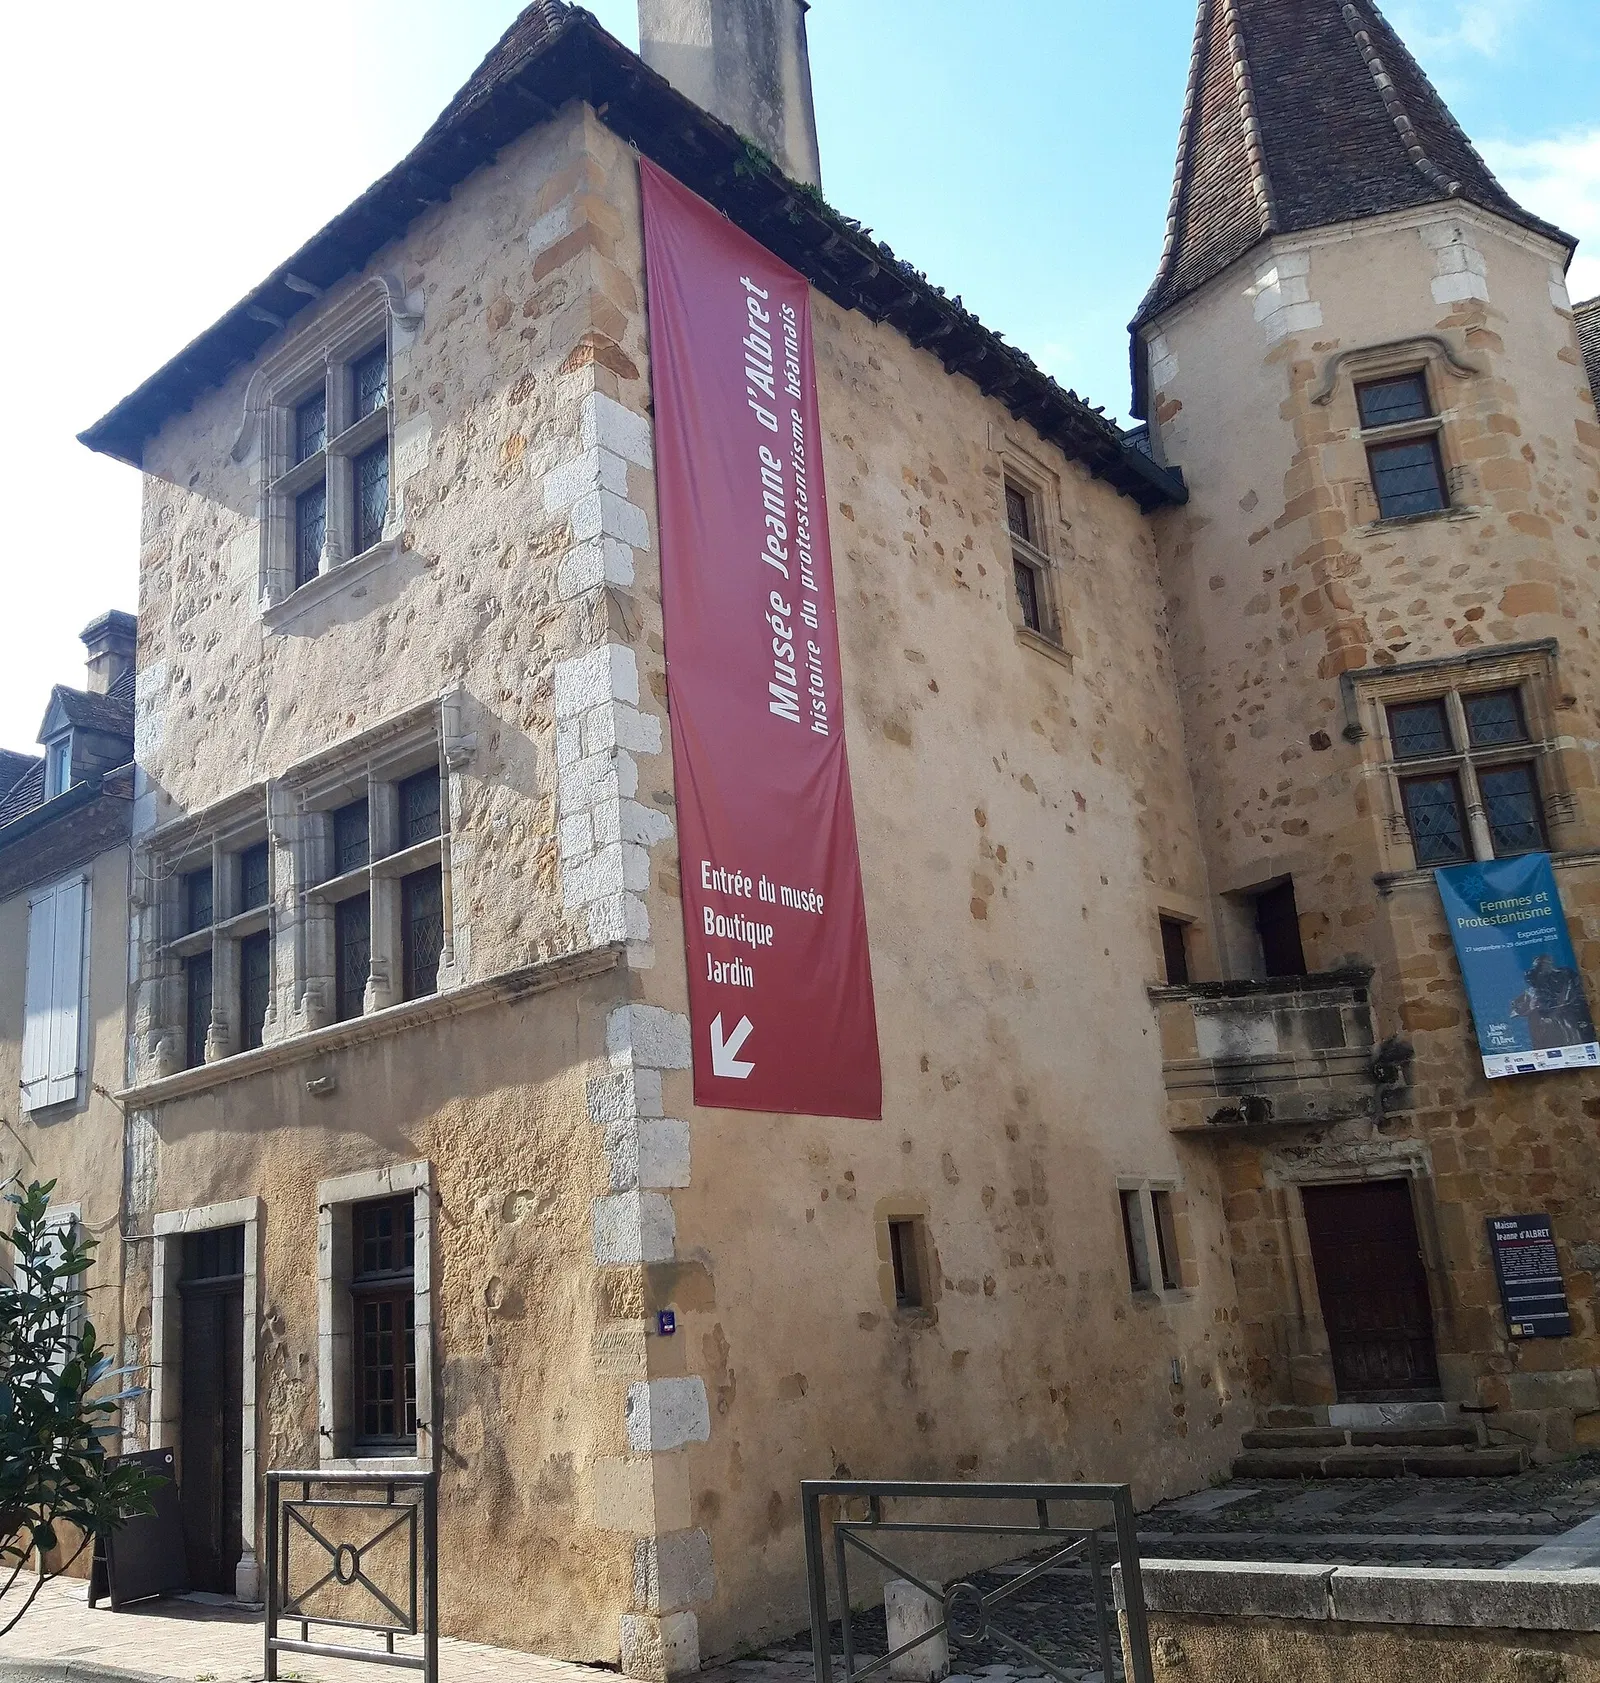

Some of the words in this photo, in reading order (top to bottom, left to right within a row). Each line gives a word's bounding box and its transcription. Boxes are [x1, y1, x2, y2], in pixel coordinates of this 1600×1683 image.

[740, 276, 779, 433] d'Albret
[778, 303, 802, 400] béarnais
[759, 445, 789, 580] Jeanne
[790, 408, 818, 592] protestantisme
[800, 600, 818, 629] du
[765, 590, 800, 723] Musée
[805, 640, 829, 736] histoire
[701, 860, 753, 898] Entrée
[758, 875, 776, 903] du
[780, 885, 824, 915] musée
[1480, 895, 1532, 913] Femmes
[1535, 891, 1549, 903] et
[703, 906, 773, 950] Boutique
[1457, 906, 1552, 929] Protestantisme
[1517, 926, 1557, 939] Exposition
[707, 952, 754, 988] Jardin
[1494, 1220, 1518, 1230] Maison
[1496, 1232, 1518, 1242] Jeanne
[1519, 1228, 1550, 1239] d'ALBRET
